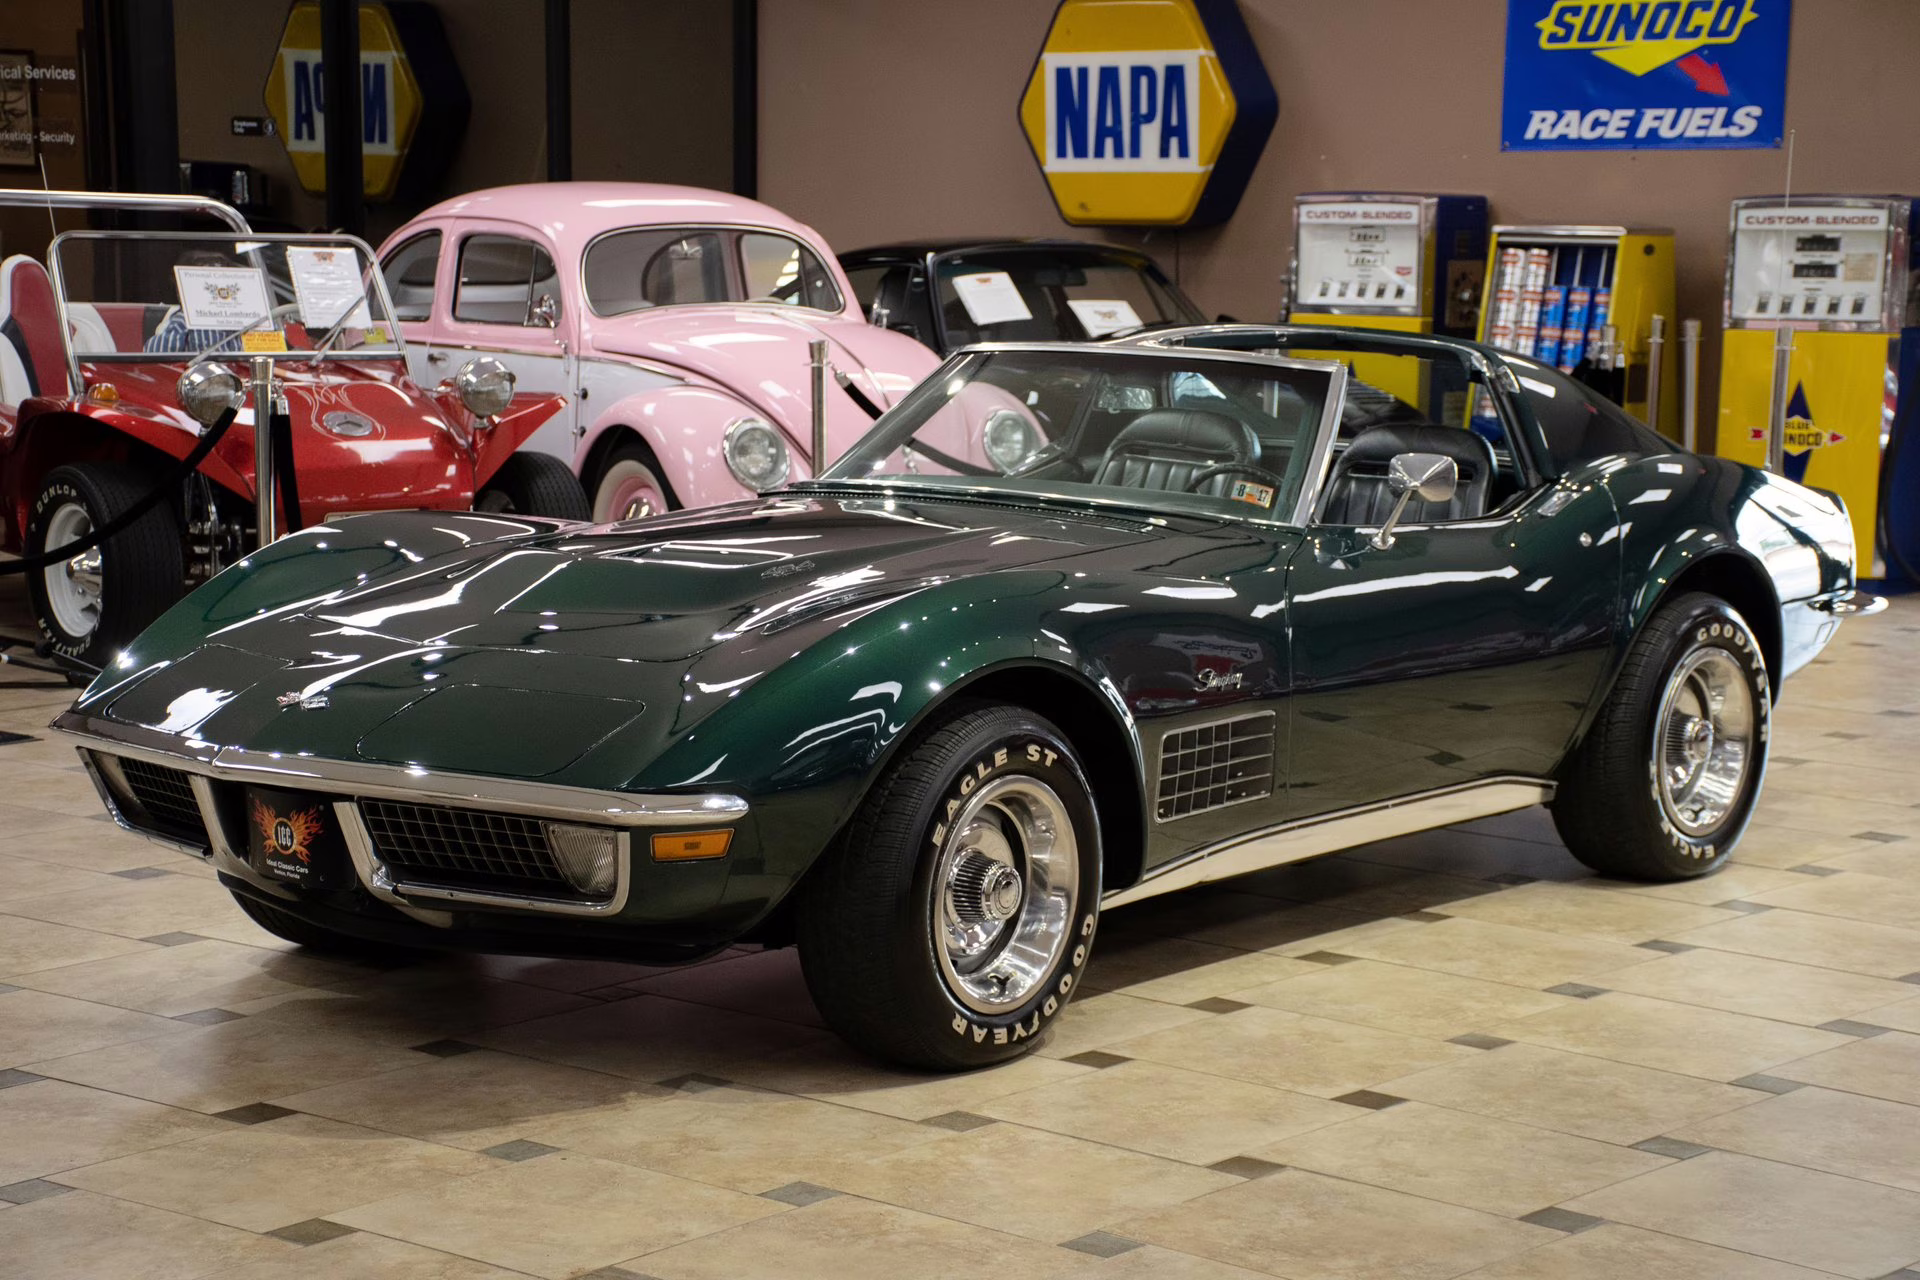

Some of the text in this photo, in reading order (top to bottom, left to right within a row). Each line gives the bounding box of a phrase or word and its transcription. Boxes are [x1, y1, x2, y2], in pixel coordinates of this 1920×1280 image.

[1547, 0, 1745, 43] SUNOCO
[24, 64, 76, 80] Services
[1056, 64, 1190, 159] NAPA
[1524, 106, 1762, 140] RACE FUELS
[40, 132, 75, 145] Security
[1784, 432, 1822, 446] NOCO
[36, 484, 77, 514] DUNLOP
[1237, 483, 1247, 497] 8
[1696, 623, 1768, 742] GOODYEAR
[932, 743, 1058, 847] EAGLE ST
[278, 861, 295, 871] Classic
[296, 865, 309, 874] Cars
[951, 914, 1094, 1045] GOODYEAR
